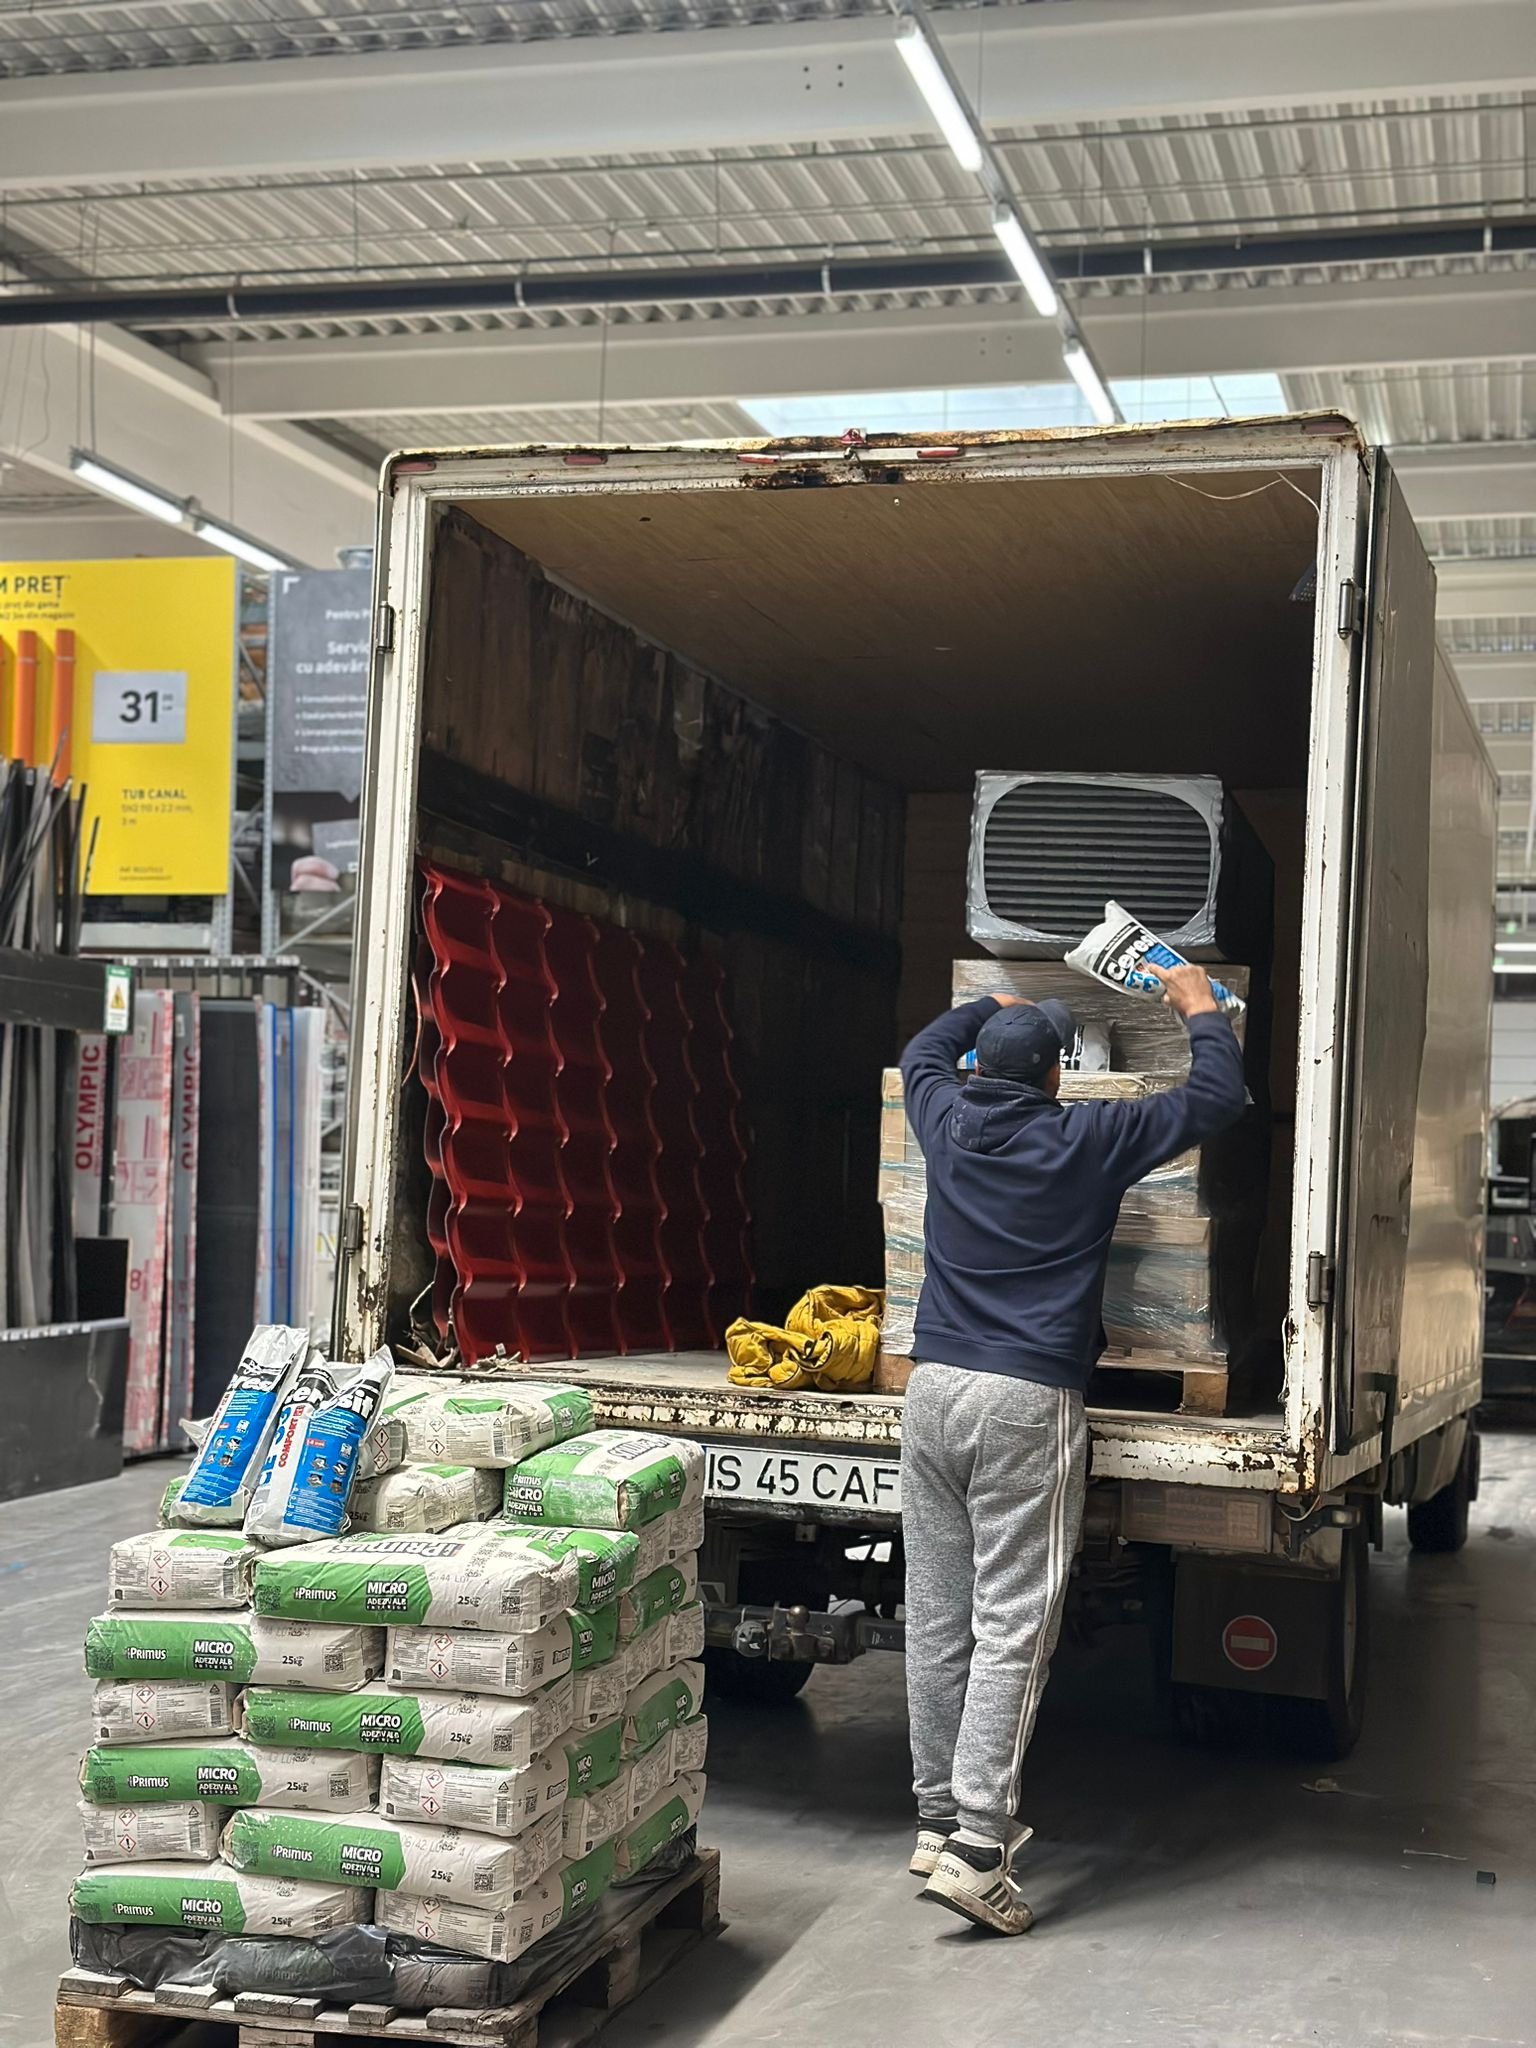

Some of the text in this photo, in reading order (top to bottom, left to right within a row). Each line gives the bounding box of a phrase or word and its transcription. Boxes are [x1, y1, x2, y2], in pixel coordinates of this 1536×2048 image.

[326, 609, 360, 620] Pentru
[296, 662, 313, 674] cu
[119, 690, 158, 723] 31
[122, 789, 187, 799] TUB CANAL
[75, 1046, 100, 1170] OLYMPIC
[278, 1418, 298, 1468] COMFORT
[707, 1453, 900, 1505] IS 45 CAF
[591, 1569, 616, 1589] MICRO
[367, 1581, 408, 1595] MICRO
[194, 1640, 234, 1654] MICRO
[361, 1714, 401, 1727] MICRO
[198, 1768, 237, 1781] MICRO
[342, 1845, 382, 1862] MICRO
[182, 1899, 222, 1913] MICRO
